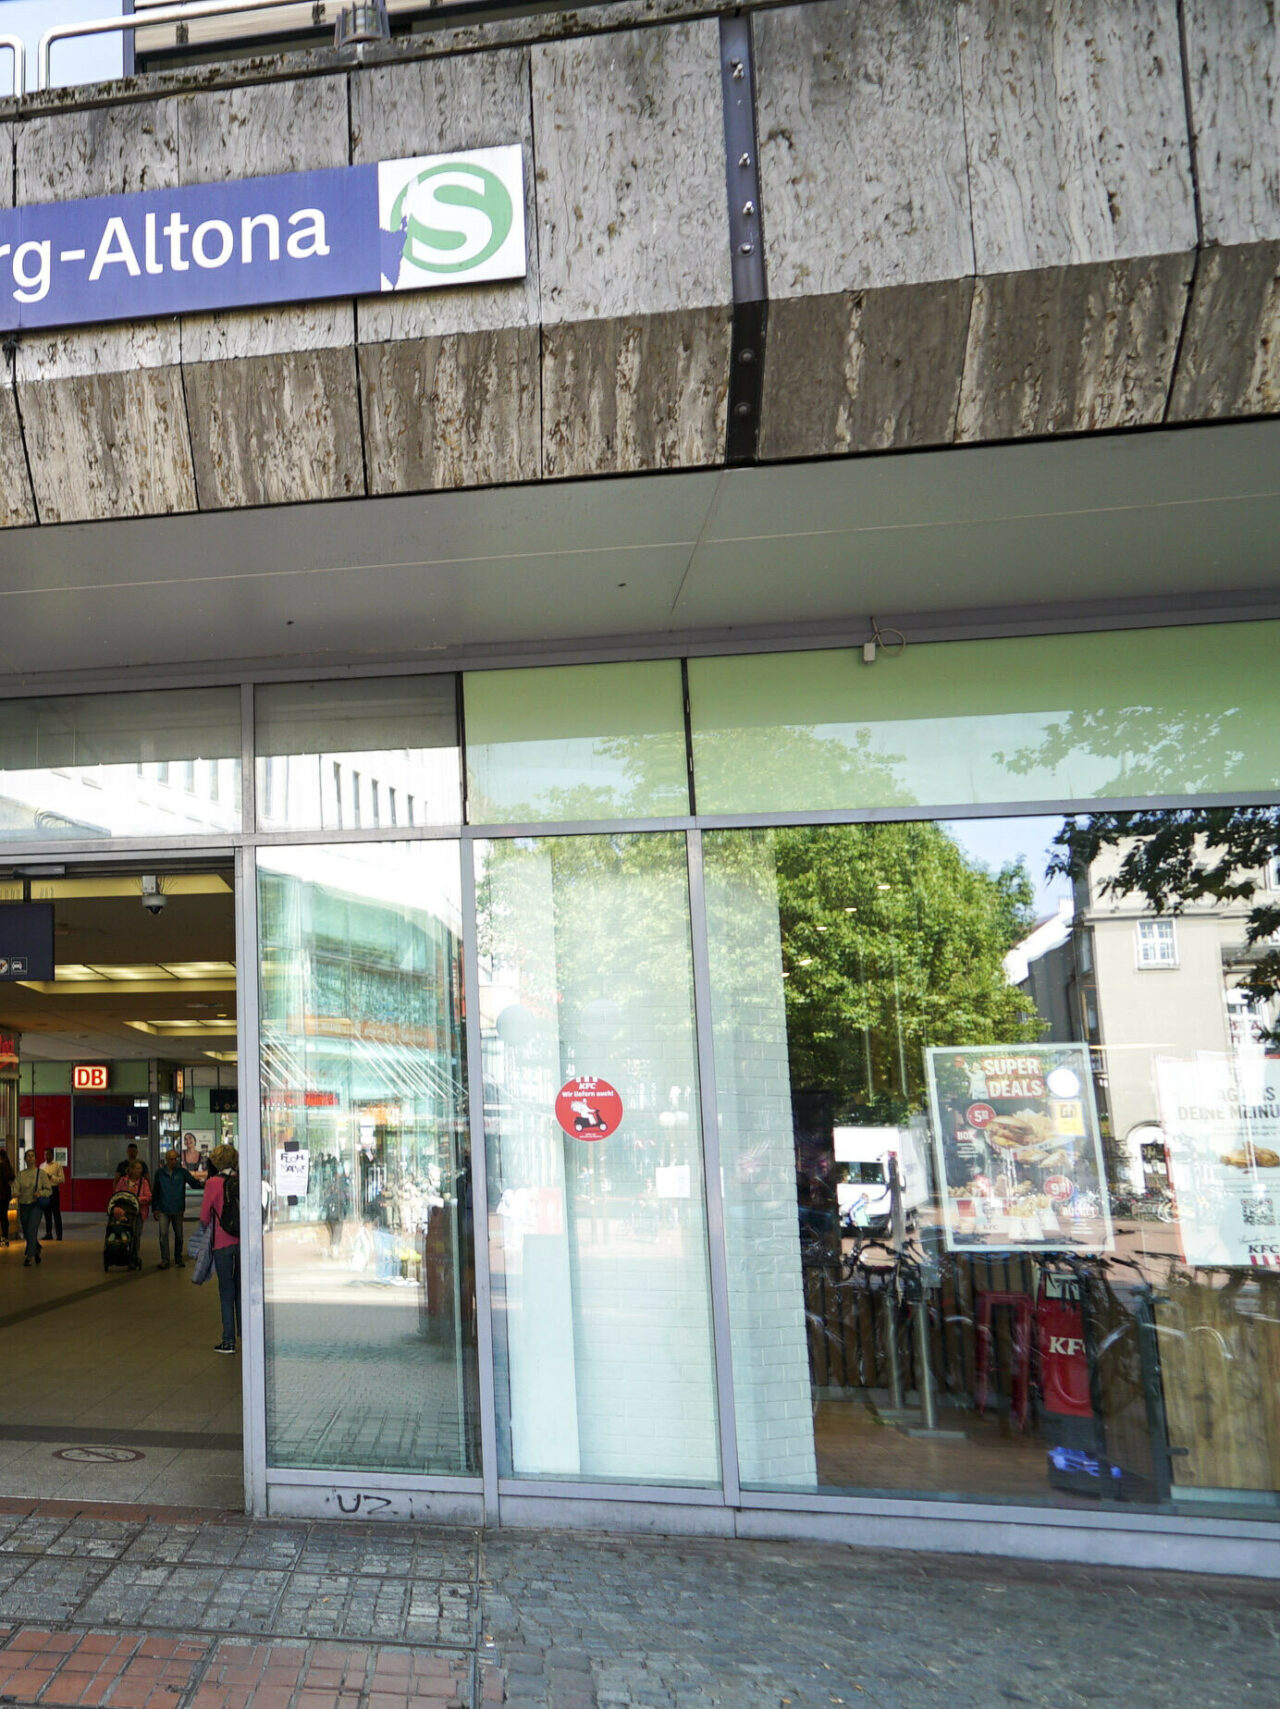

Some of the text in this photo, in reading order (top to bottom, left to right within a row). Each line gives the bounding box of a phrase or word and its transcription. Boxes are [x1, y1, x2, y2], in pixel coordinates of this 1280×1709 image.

[408, 165, 505, 264] S
[983, 1057, 1040, 1076] SUPER
[76, 1068, 105, 1087] DB
[989, 1079, 1044, 1097] DEALS
